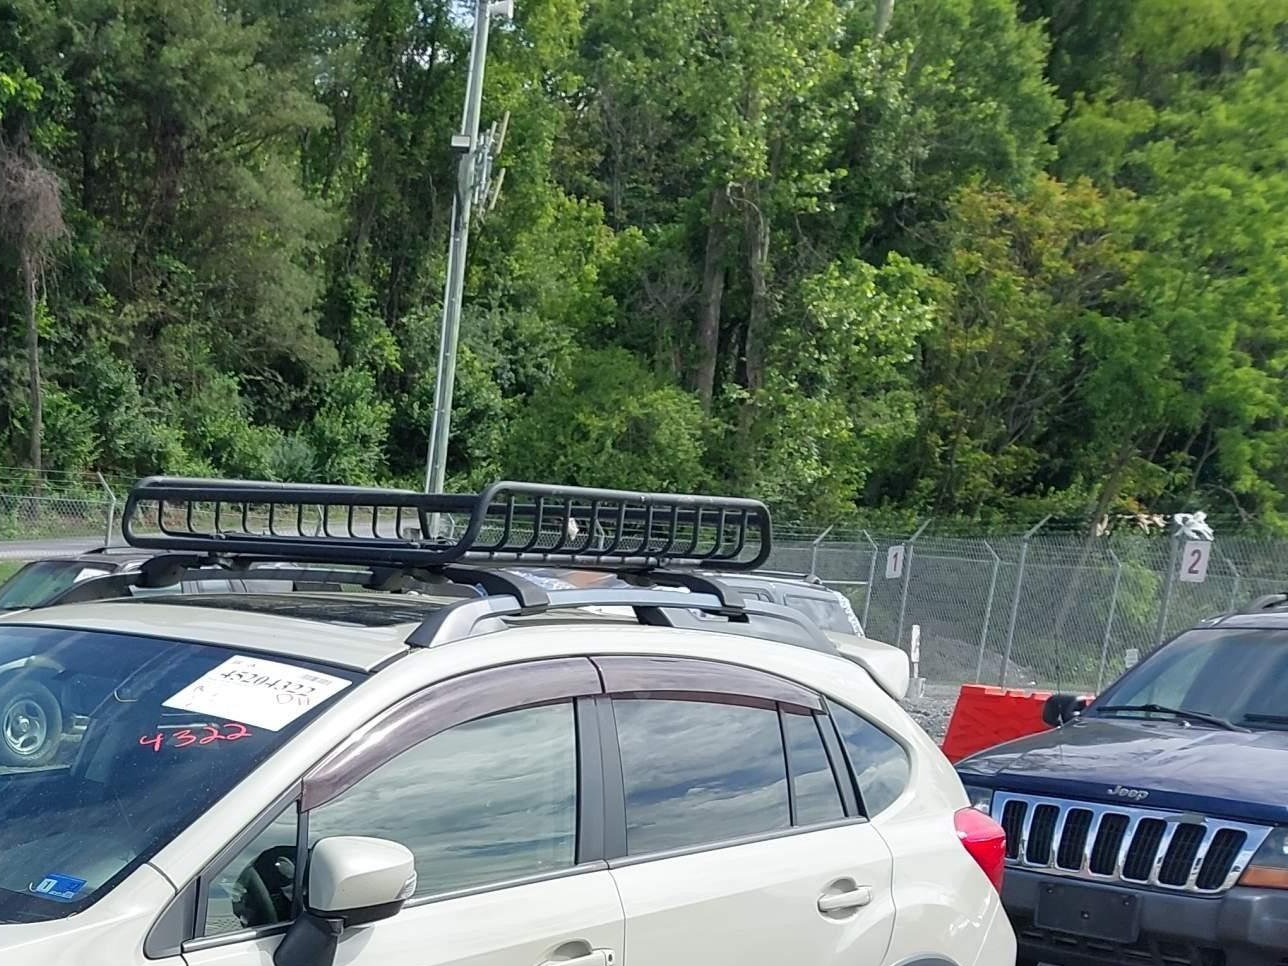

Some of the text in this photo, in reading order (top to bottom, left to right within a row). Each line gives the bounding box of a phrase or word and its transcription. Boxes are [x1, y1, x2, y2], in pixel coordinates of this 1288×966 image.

[892, 553, 898, 571] 1
[1187, 549, 1202, 575] 2
[220, 669, 317, 697] 45204322
[139, 723, 253, 751] 4322
[1108, 784, 1149, 801] Jeep
